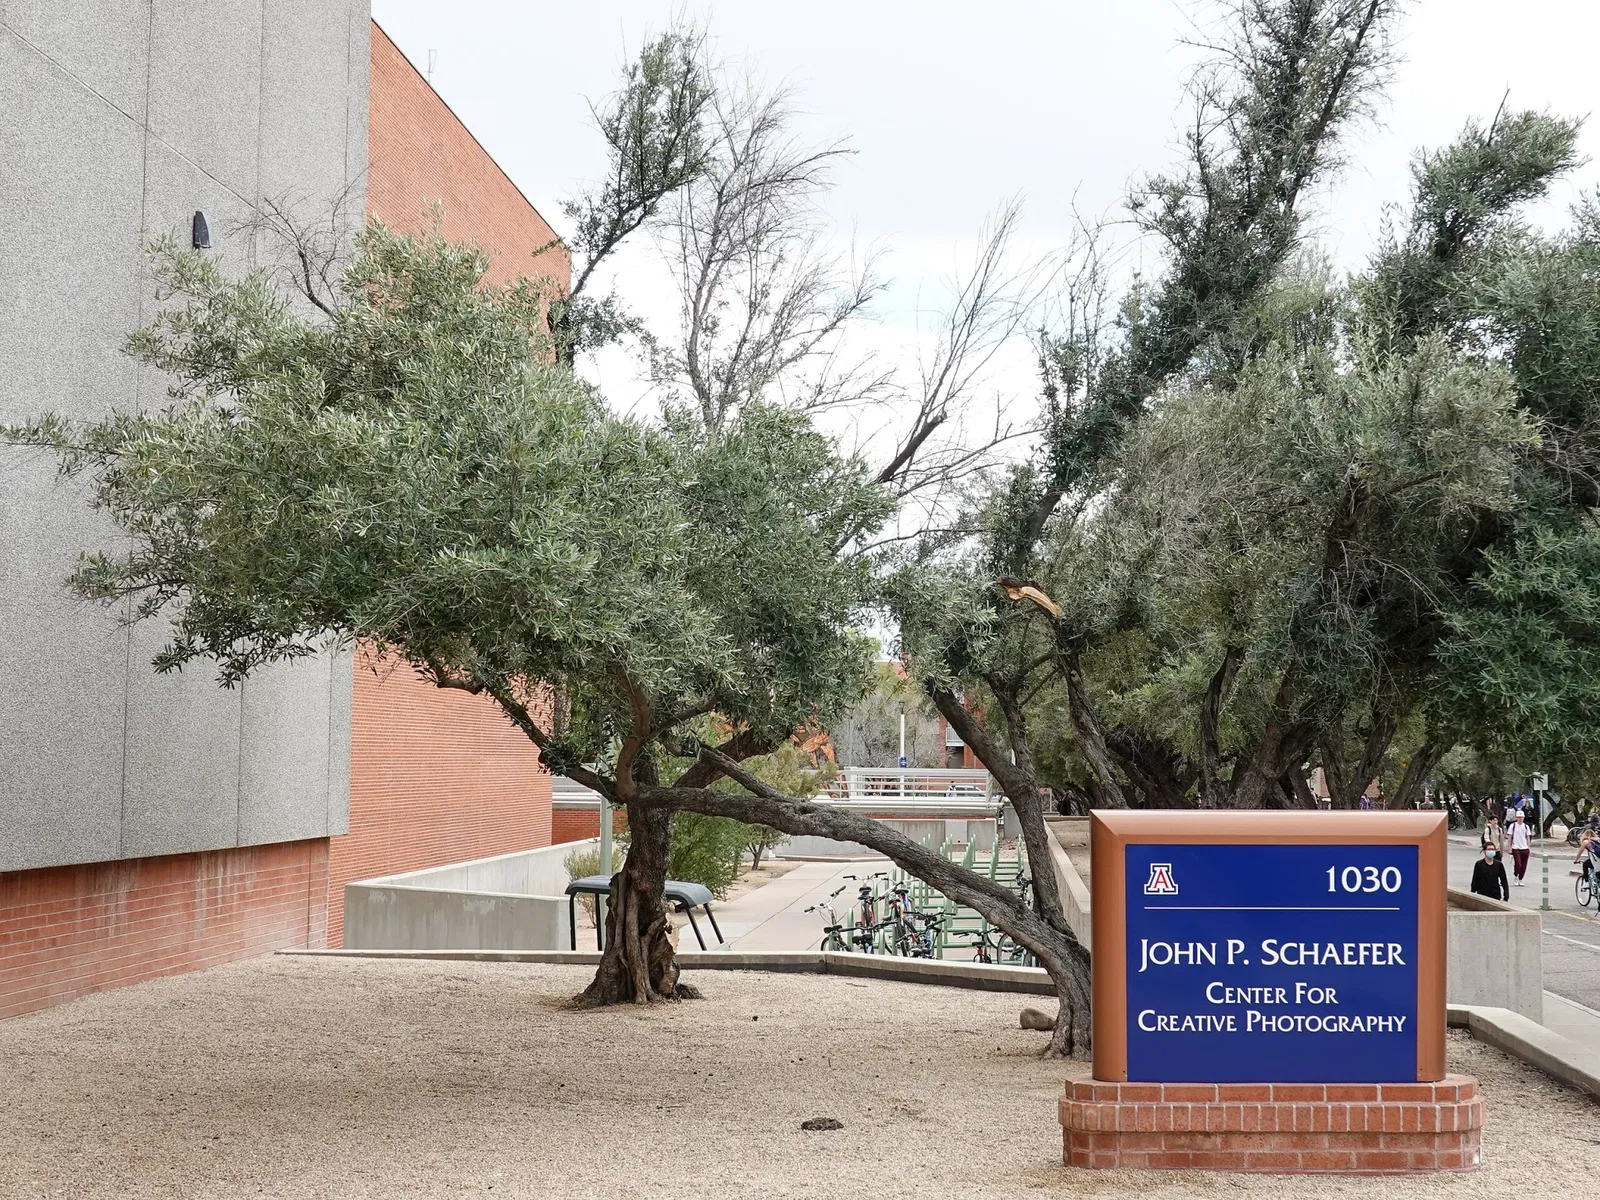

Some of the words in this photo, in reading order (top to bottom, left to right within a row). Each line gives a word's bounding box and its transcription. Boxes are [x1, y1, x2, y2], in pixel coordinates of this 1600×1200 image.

[1144, 863, 1178, 895] A
[1326, 866, 1402, 893] 1030
[1138, 938, 1216, 972] JOHN
[1227, 939, 1250, 965] P.
[1261, 938, 1406, 966] SCHAEFER
[1206, 981, 1288, 1004] CENTER
[1295, 982, 1338, 1004] FOR
[1138, 1009, 1237, 1032] CREATIVE
[1246, 1009, 1406, 1032] PHOTOGRAPHY
